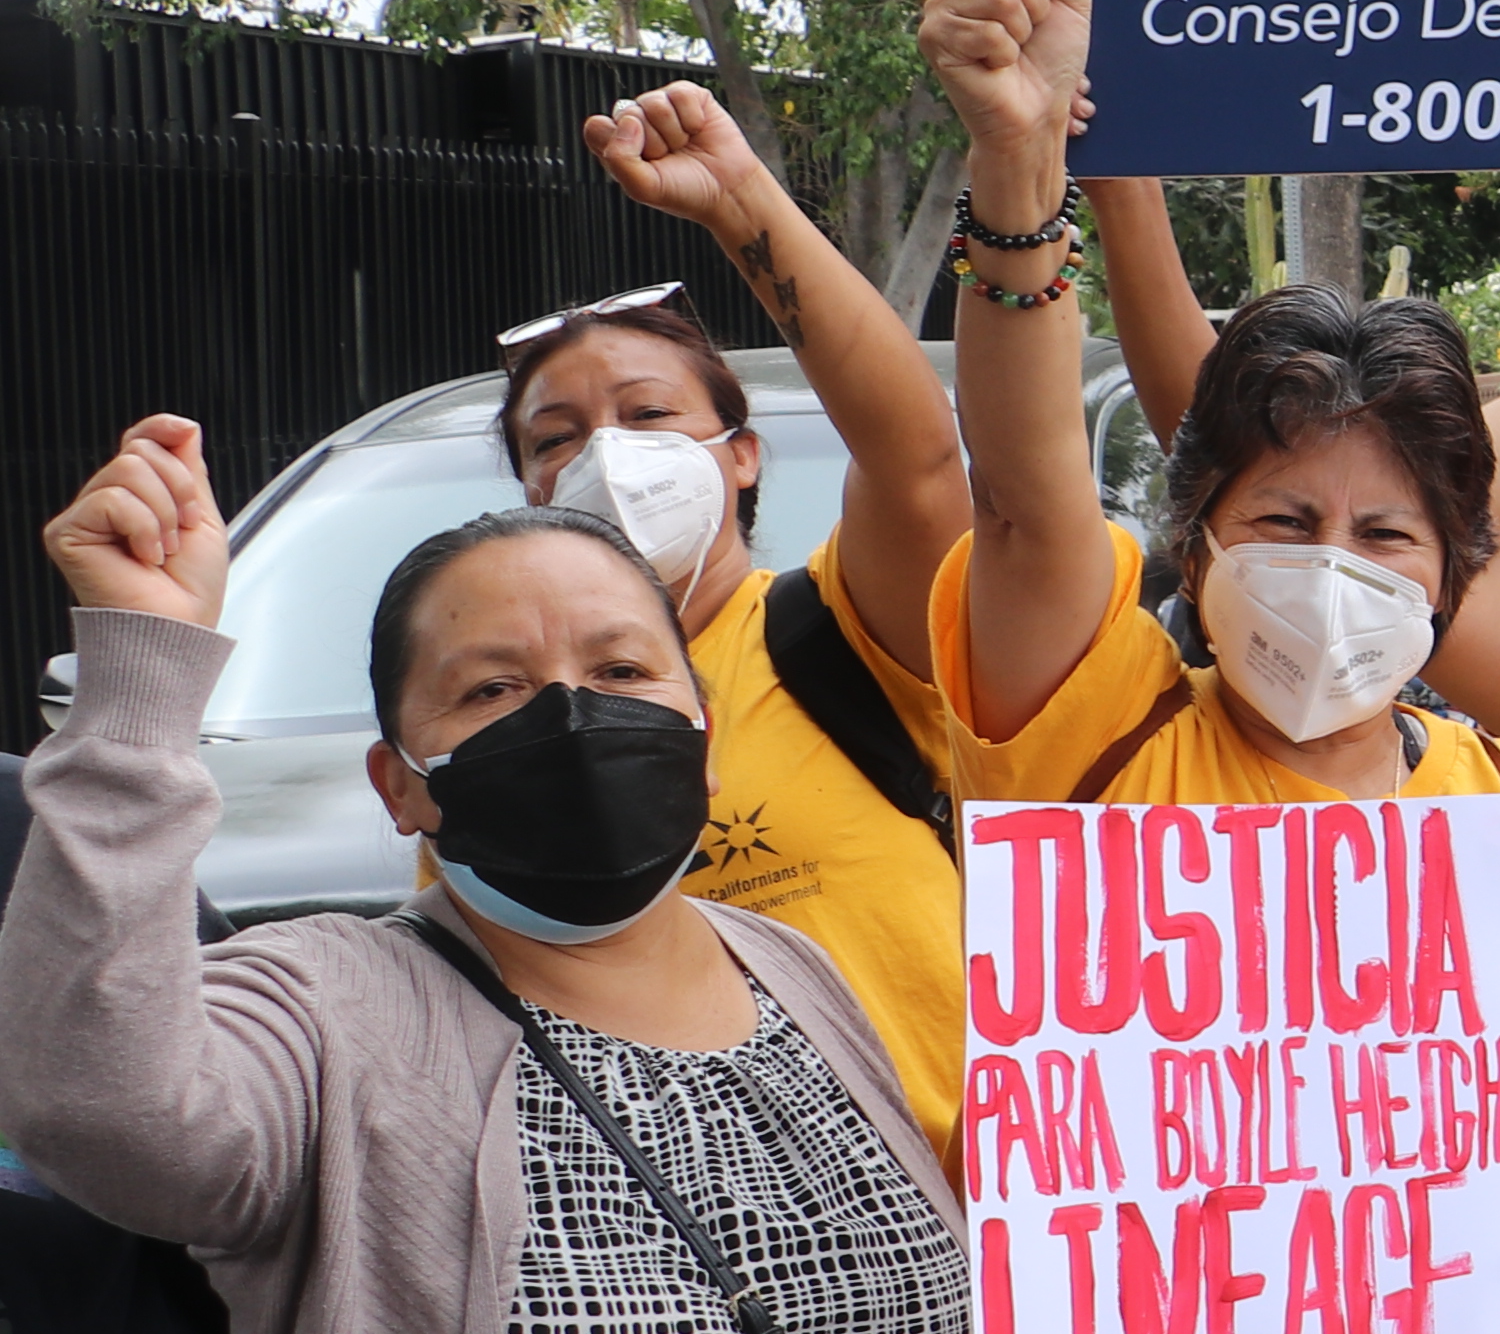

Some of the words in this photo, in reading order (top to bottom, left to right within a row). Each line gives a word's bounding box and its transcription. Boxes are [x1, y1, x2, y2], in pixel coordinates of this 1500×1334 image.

[1273, 648, 1306, 682] 9502+
[708, 865, 799, 903] Californians
[802, 859, 819, 875] for
[968, 801, 1488, 1046] JUSTICIA
[968, 1050, 1125, 1202] PARA
[1153, 1035, 1319, 1193] BOYLE
